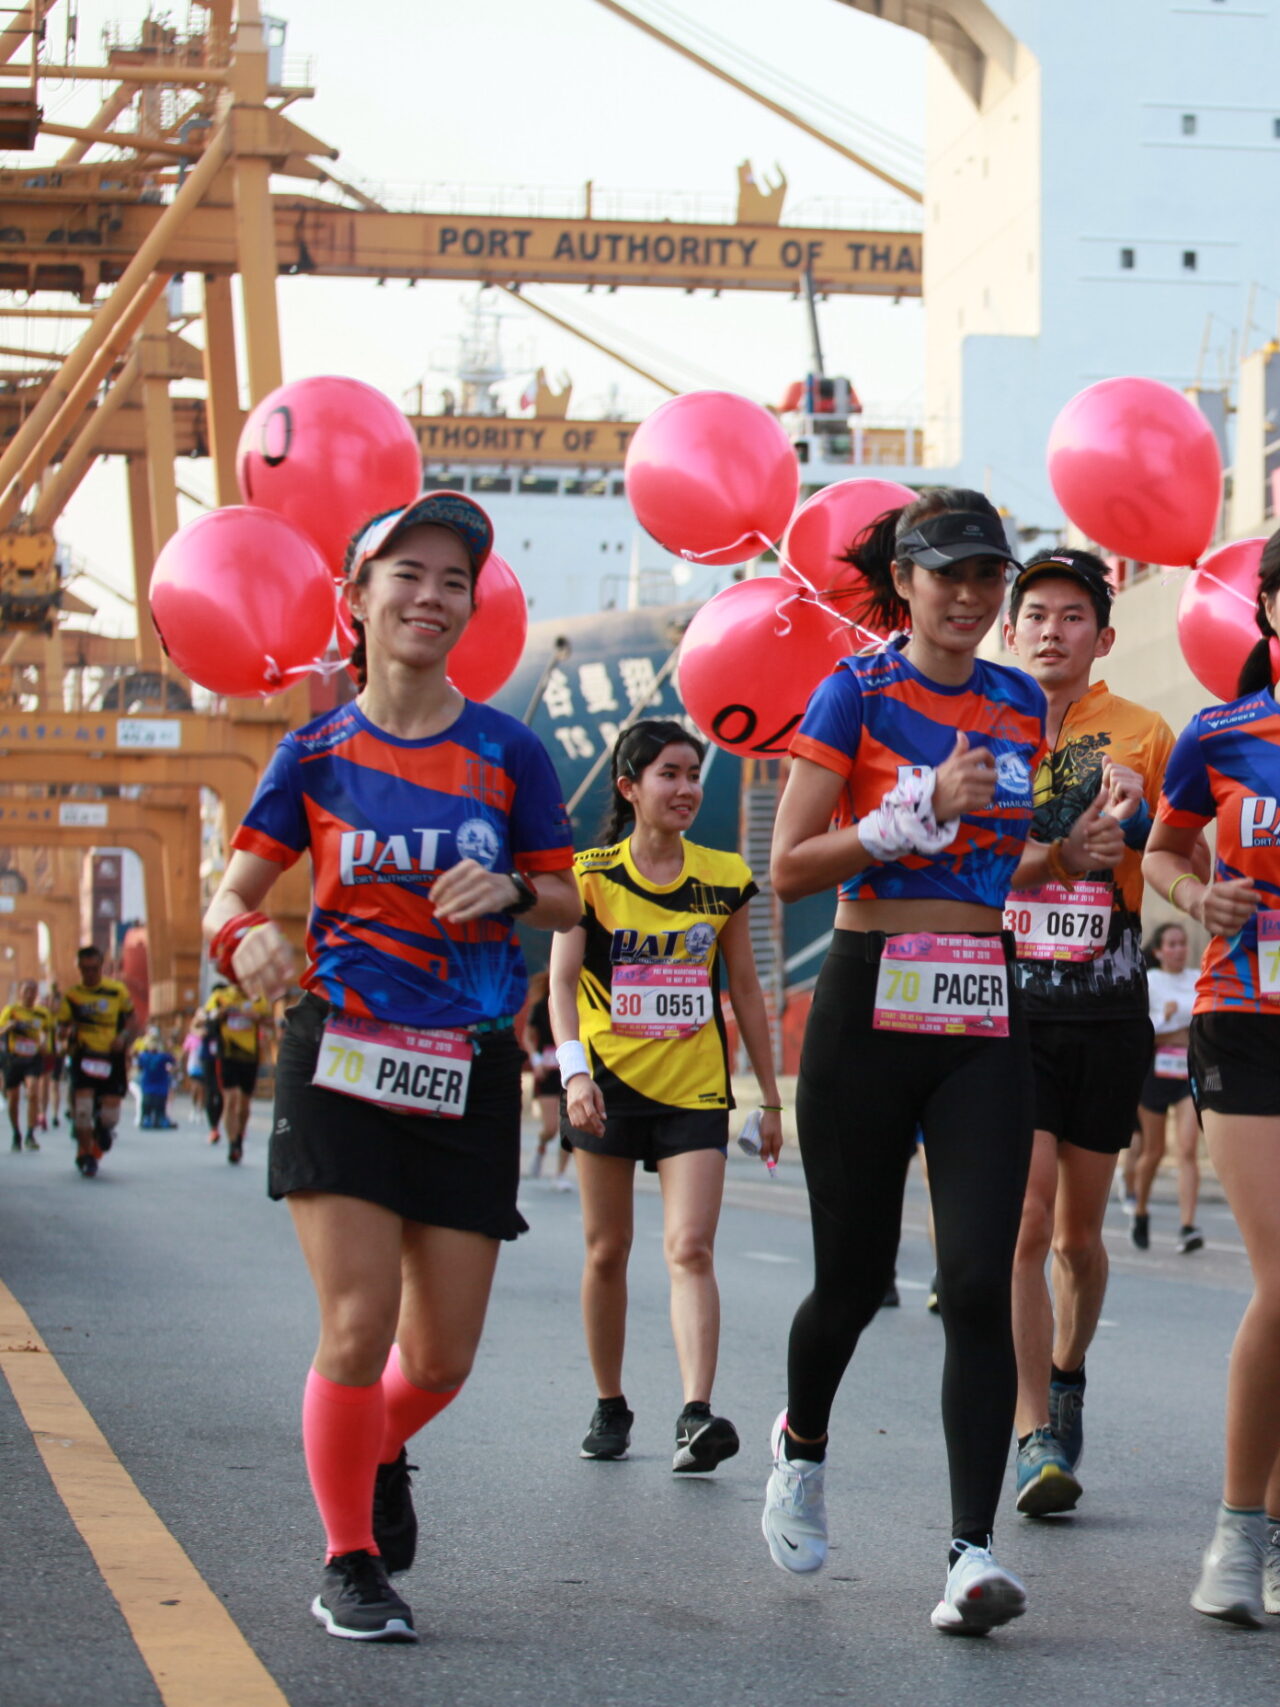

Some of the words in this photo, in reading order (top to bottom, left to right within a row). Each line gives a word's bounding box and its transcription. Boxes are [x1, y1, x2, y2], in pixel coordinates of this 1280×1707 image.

[438, 227, 532, 258] PORT
[553, 231, 758, 267] AUTHORITY
[780, 239, 823, 269] OF
[563, 429, 597, 451] OF
[340, 828, 452, 886] PAT
[1004, 909, 1031, 934] 30
[1047, 912, 1104, 938] 0678
[610, 929, 687, 962] PAT
[962, 950, 975, 958] MAY
[885, 969, 920, 1003] 70
[932, 972, 1004, 1006] PACER
[616, 993, 642, 1016] 30
[656, 993, 704, 1016] 0551
[324, 1045, 365, 1084] 70
[376, 1057, 463, 1104] PACER
